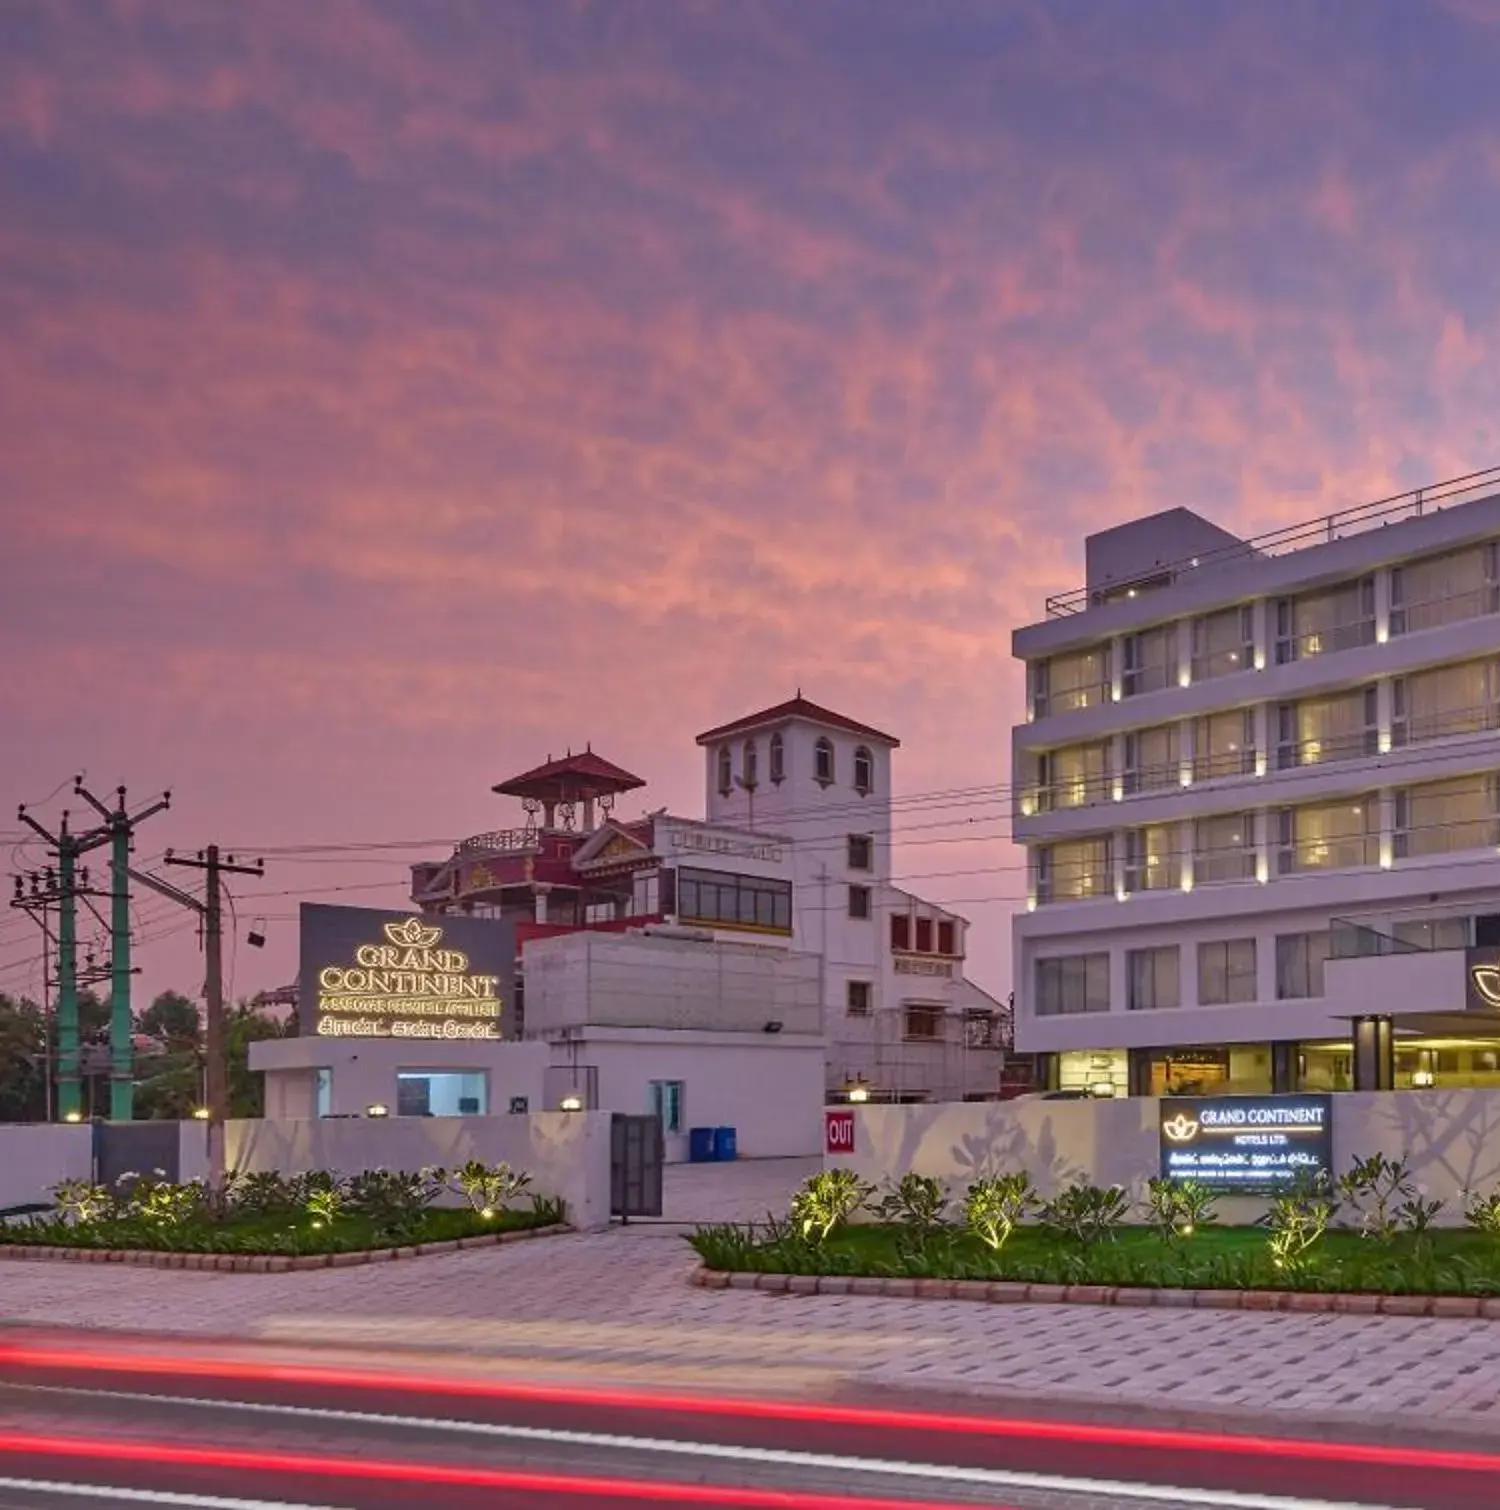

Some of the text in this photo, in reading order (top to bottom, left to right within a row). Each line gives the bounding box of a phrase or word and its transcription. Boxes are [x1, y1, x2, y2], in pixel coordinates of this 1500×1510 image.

[357, 945, 467, 972] GRAND
[320, 967, 496, 997] CONTINENT
[1200, 1107, 1324, 1124] GRAND CONTINENT
[829, 1119, 852, 1145] OUT
[1235, 1135, 1267, 1145] HOTELS
